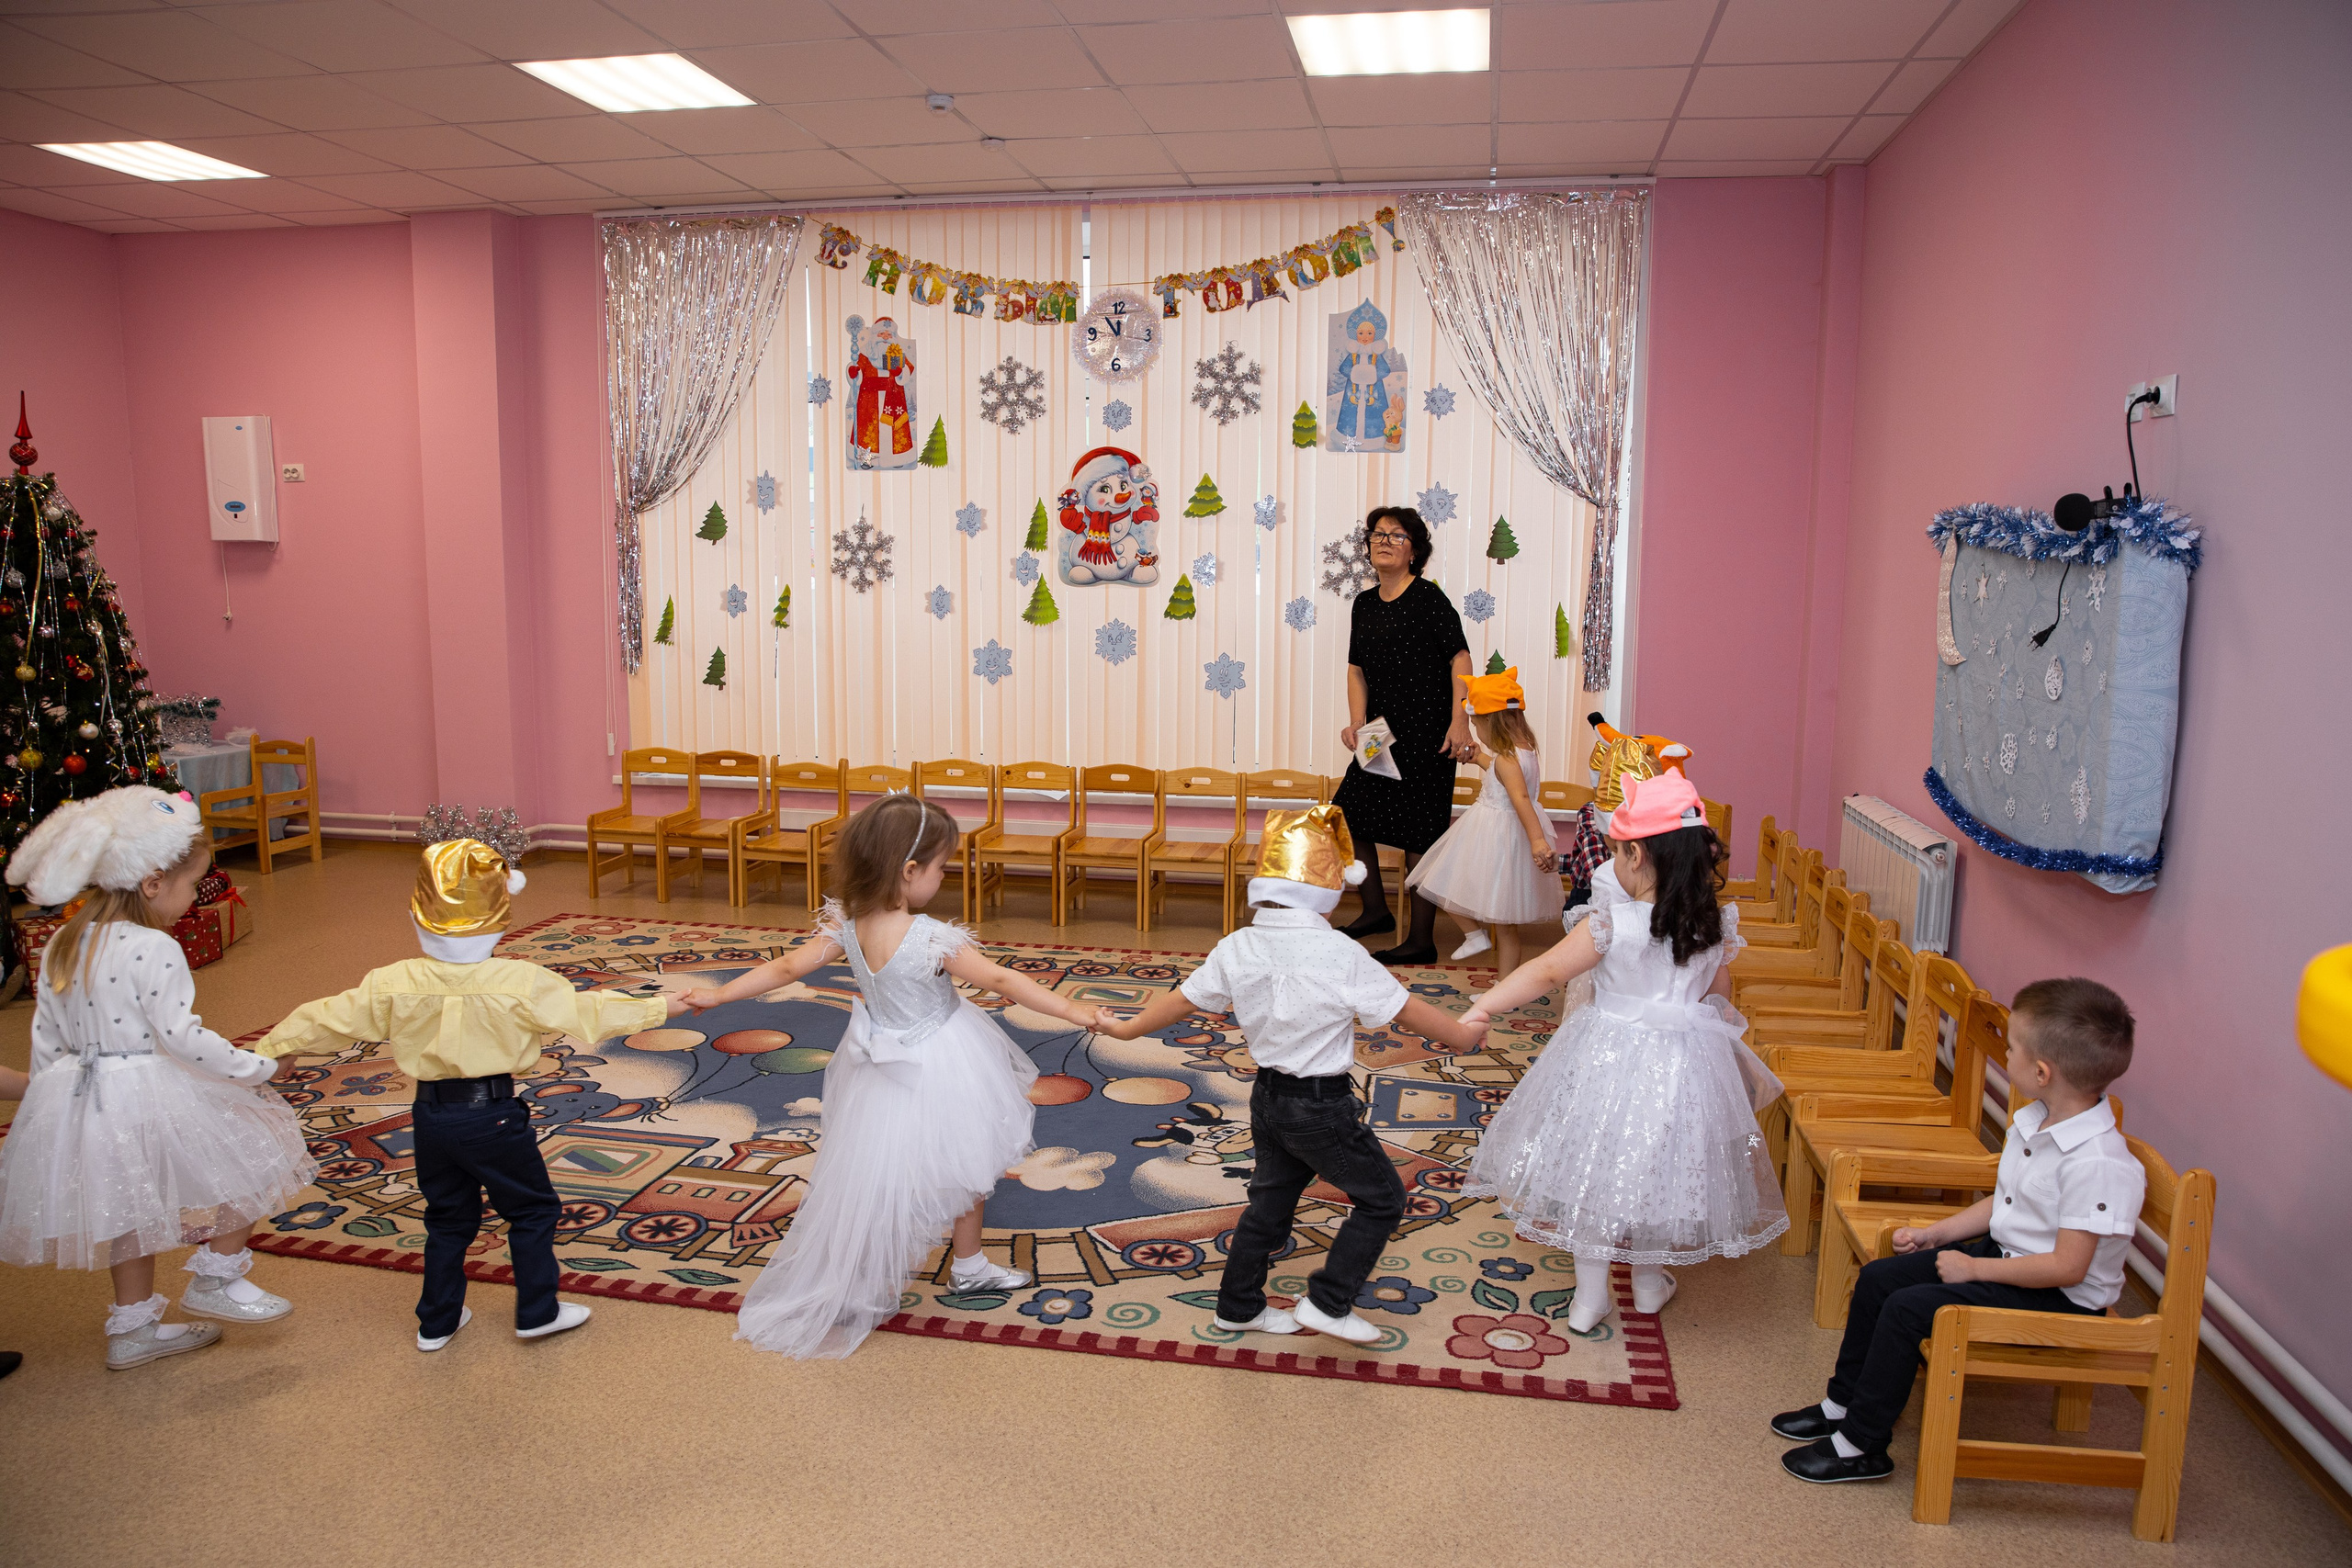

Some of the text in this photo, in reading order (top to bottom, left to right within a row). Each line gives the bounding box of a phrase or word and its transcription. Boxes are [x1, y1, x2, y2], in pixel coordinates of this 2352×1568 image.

[862, 250, 1079, 325] НОВЫМ
[1112, 301, 1126, 315] 12
[1087, 327, 1097, 341] 9
[1143, 328, 1152, 342] 3
[1111, 357, 1121, 372] 6
